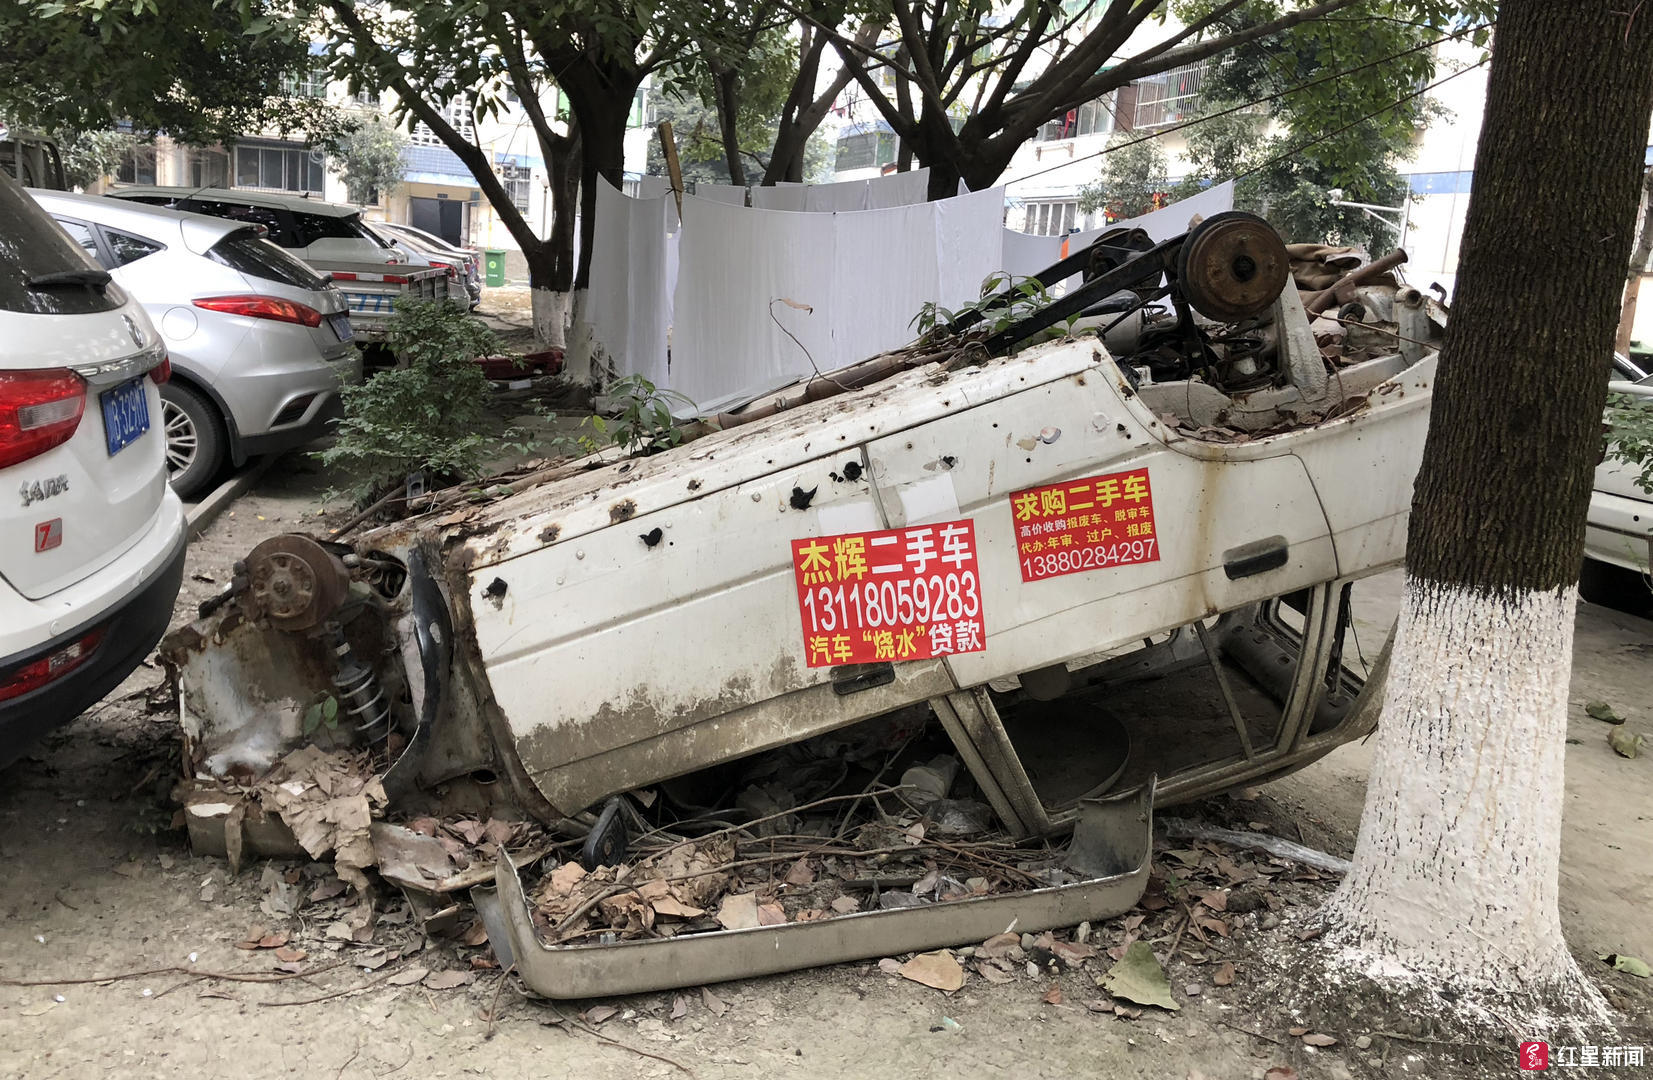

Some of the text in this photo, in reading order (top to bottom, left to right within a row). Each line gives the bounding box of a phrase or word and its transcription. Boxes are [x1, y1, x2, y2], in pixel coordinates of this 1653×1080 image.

[1014, 475, 1149, 521] 求购二手车
[39, 523, 52, 550] 7
[798, 524, 973, 586] 杰辉二手车
[1023, 538, 1155, 578] 13880284297
[804, 570, 979, 632] 13118059283
